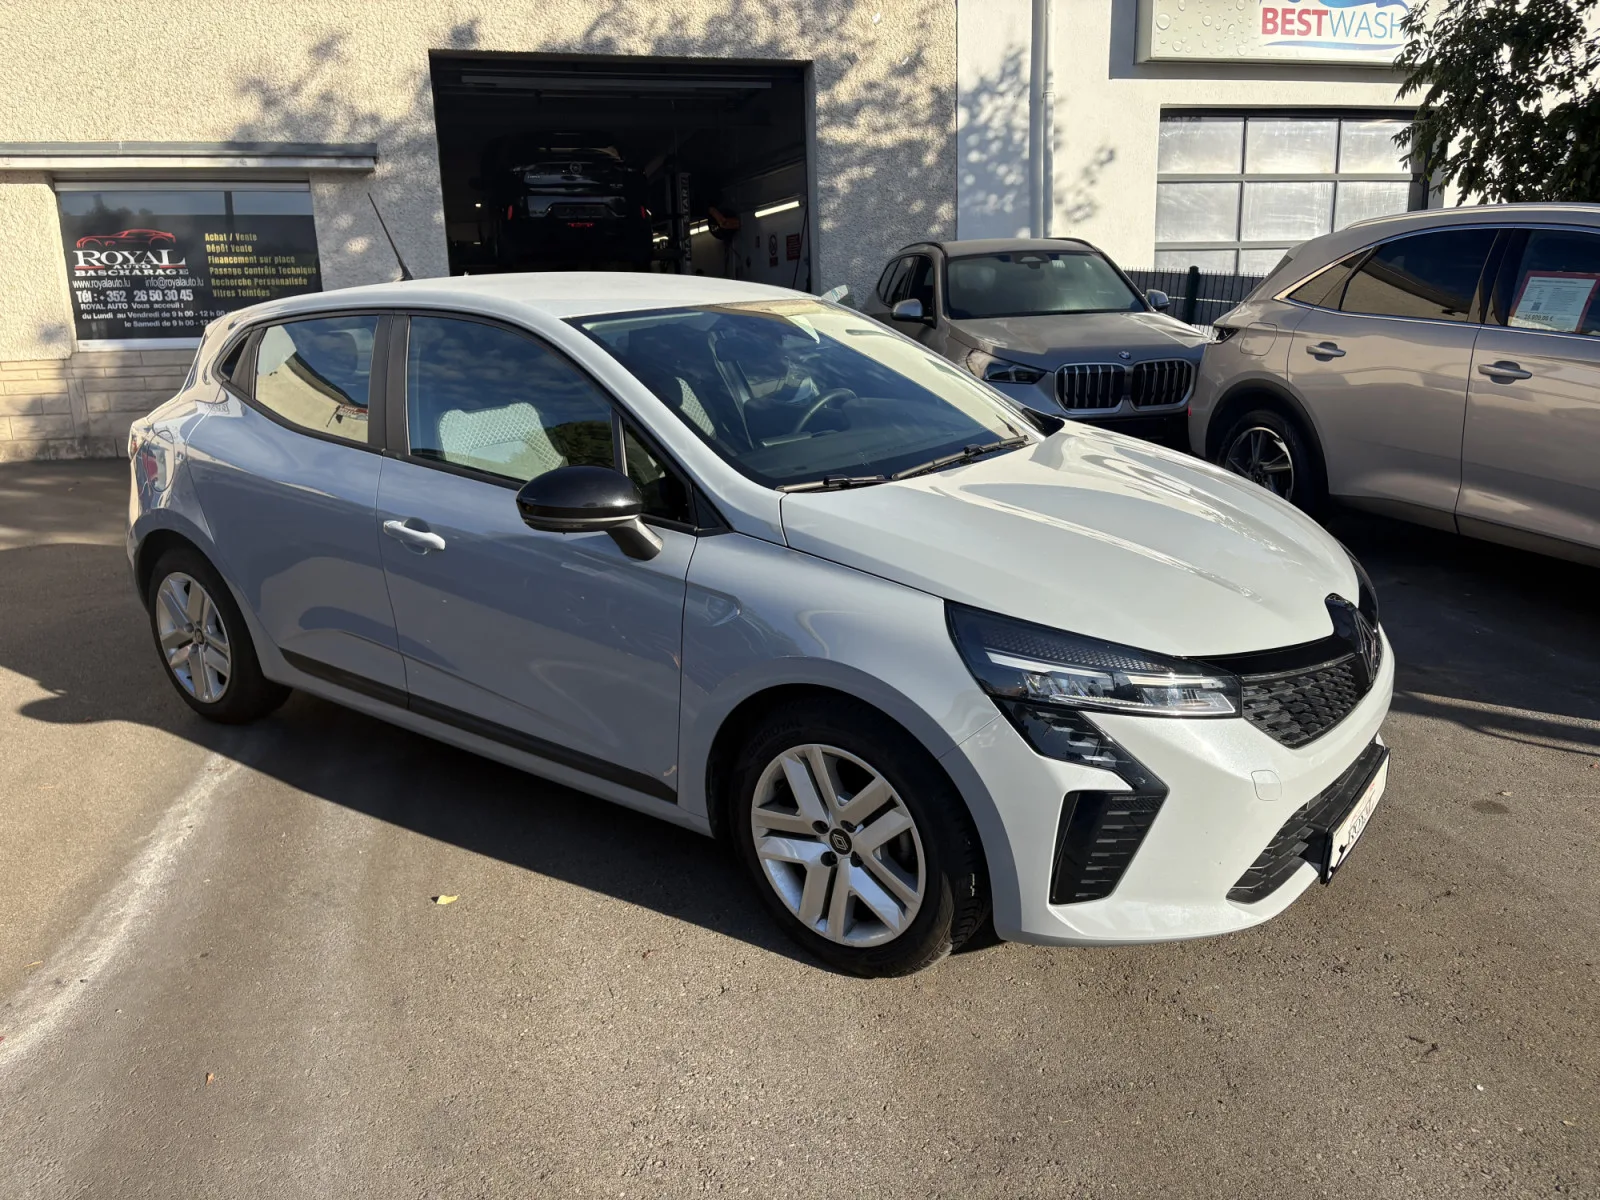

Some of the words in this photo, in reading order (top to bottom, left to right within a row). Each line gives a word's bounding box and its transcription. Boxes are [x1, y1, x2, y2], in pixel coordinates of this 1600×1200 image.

[205, 233, 227, 242] Achat
[235, 233, 258, 241] Vente
[231, 244, 253, 253] Vente
[73, 249, 186, 266] ROYAL
[208, 255, 257, 264] Financement
[274, 255, 296, 265] place
[74, 268, 189, 277] BASCHARAGE
[209, 266, 242, 276] Passage
[278, 266, 317, 275] Technique
[72, 277, 131, 290] www.royalauto.lu
[145, 276, 205, 290] info@royalauto.lu
[211, 277, 252, 287] Recherche
[106, 290, 128, 302] 352
[133, 290, 148, 302] 26
[149, 289, 163, 301] 50
[164, 290, 179, 301] 30
[180, 289, 194, 301] 45
[212, 289, 236, 298] Vitres
[107, 302, 129, 310] AUTO
[127, 311, 160, 319] Vendredi
[133, 320, 160, 328] Samedi
